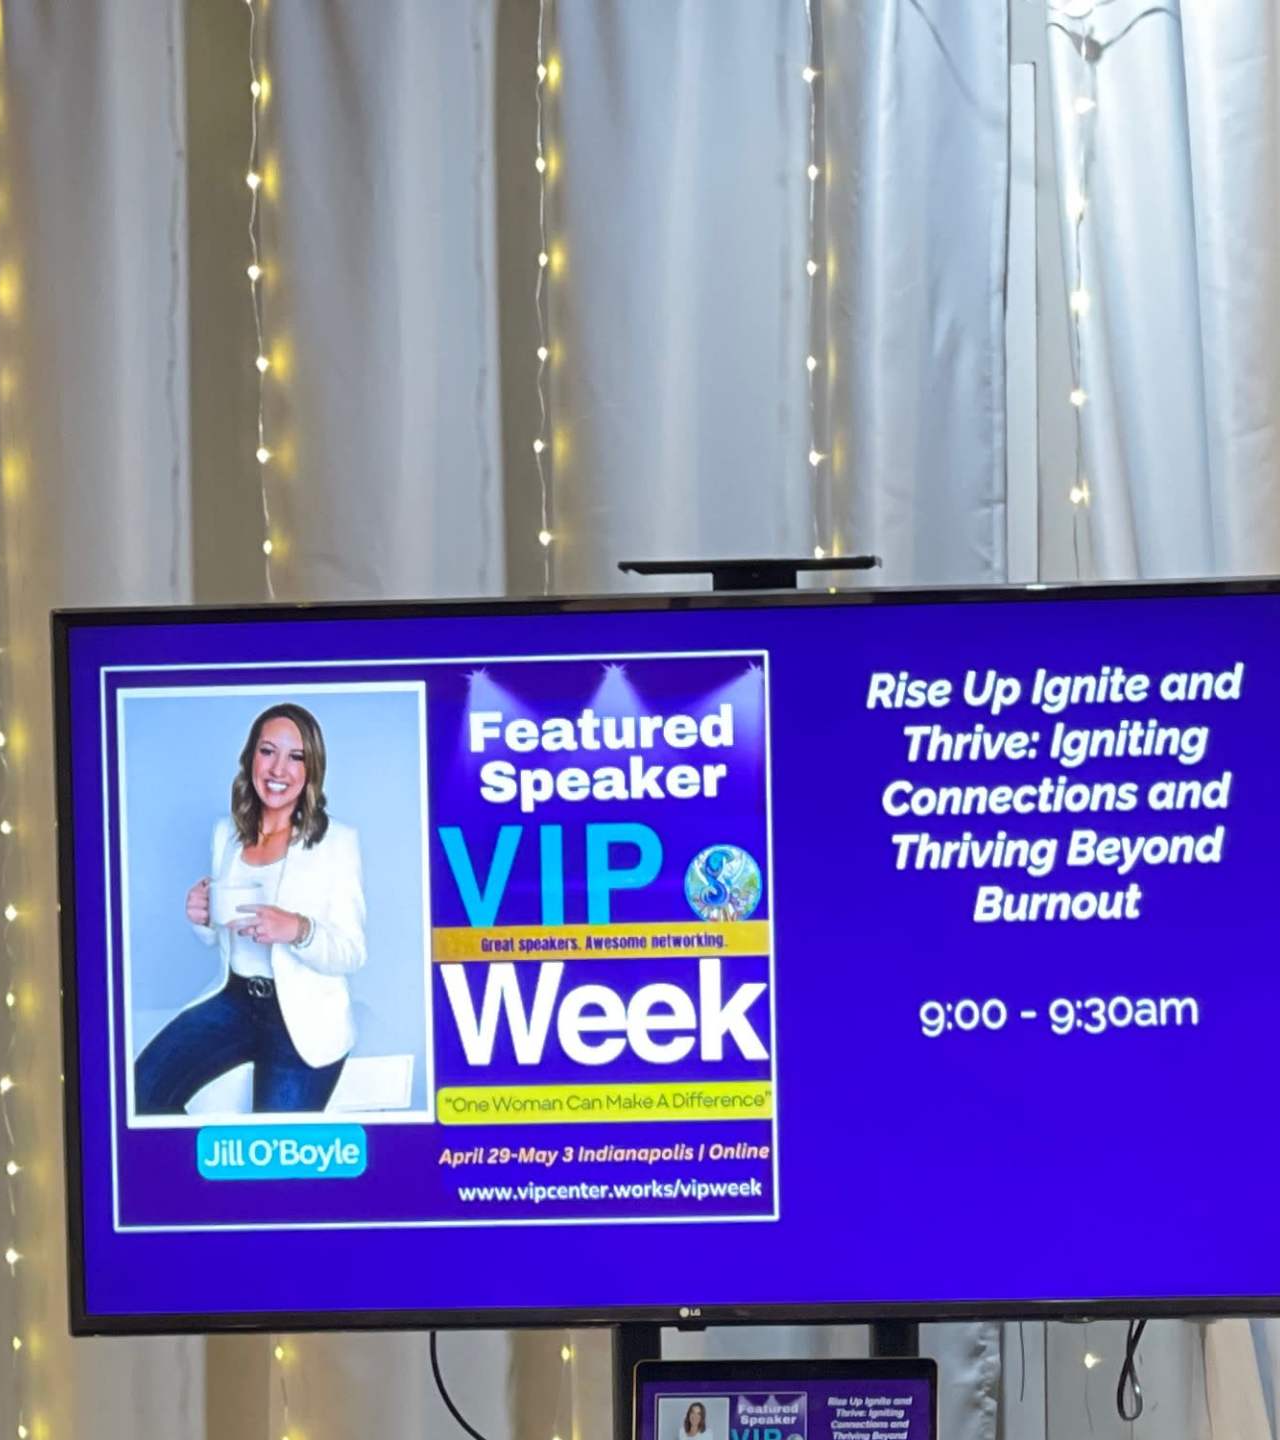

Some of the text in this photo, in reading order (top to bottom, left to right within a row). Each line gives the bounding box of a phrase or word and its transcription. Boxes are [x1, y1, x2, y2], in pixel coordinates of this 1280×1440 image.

[866, 662, 1245, 715] Rise Up Ignite and
[469, 703, 734, 752] Featured
[903, 719, 1209, 768] Thrive: Igniting
[479, 755, 727, 813] Speaker
[881, 771, 1233, 817] Connections and
[891, 826, 1226, 877] Thriving Beyond
[437, 822, 663, 928] VIP
[973, 883, 1143, 923] Burnout
[480, 932, 728, 953] Great speakers. Awesome networking.
[439, 958, 770, 1066] Week
[919, 998, 1008, 1038] 9:00
[1048, 996, 1199, 1035] 9:30am
[491, 1095, 564, 1113] Woman
[566, 1094, 603, 1111] Can
[605, 1093, 653, 1110] Make
[656, 1092, 670, 1108] A
[203, 1137, 361, 1173] Jill O'Boyle
[439, 1147, 484, 1168] April
[487, 1146, 558, 1168] 29-May
[562, 1147, 575, 1163] 3
[578, 1143, 694, 1165] Indianapolis
[708, 1143, 770, 1161] Online
[458, 1177, 762, 1204] www.vipcenter.works/vipweek
[738, 1404, 799, 1415] Featured
[740, 1415, 797, 1427] Speaker
